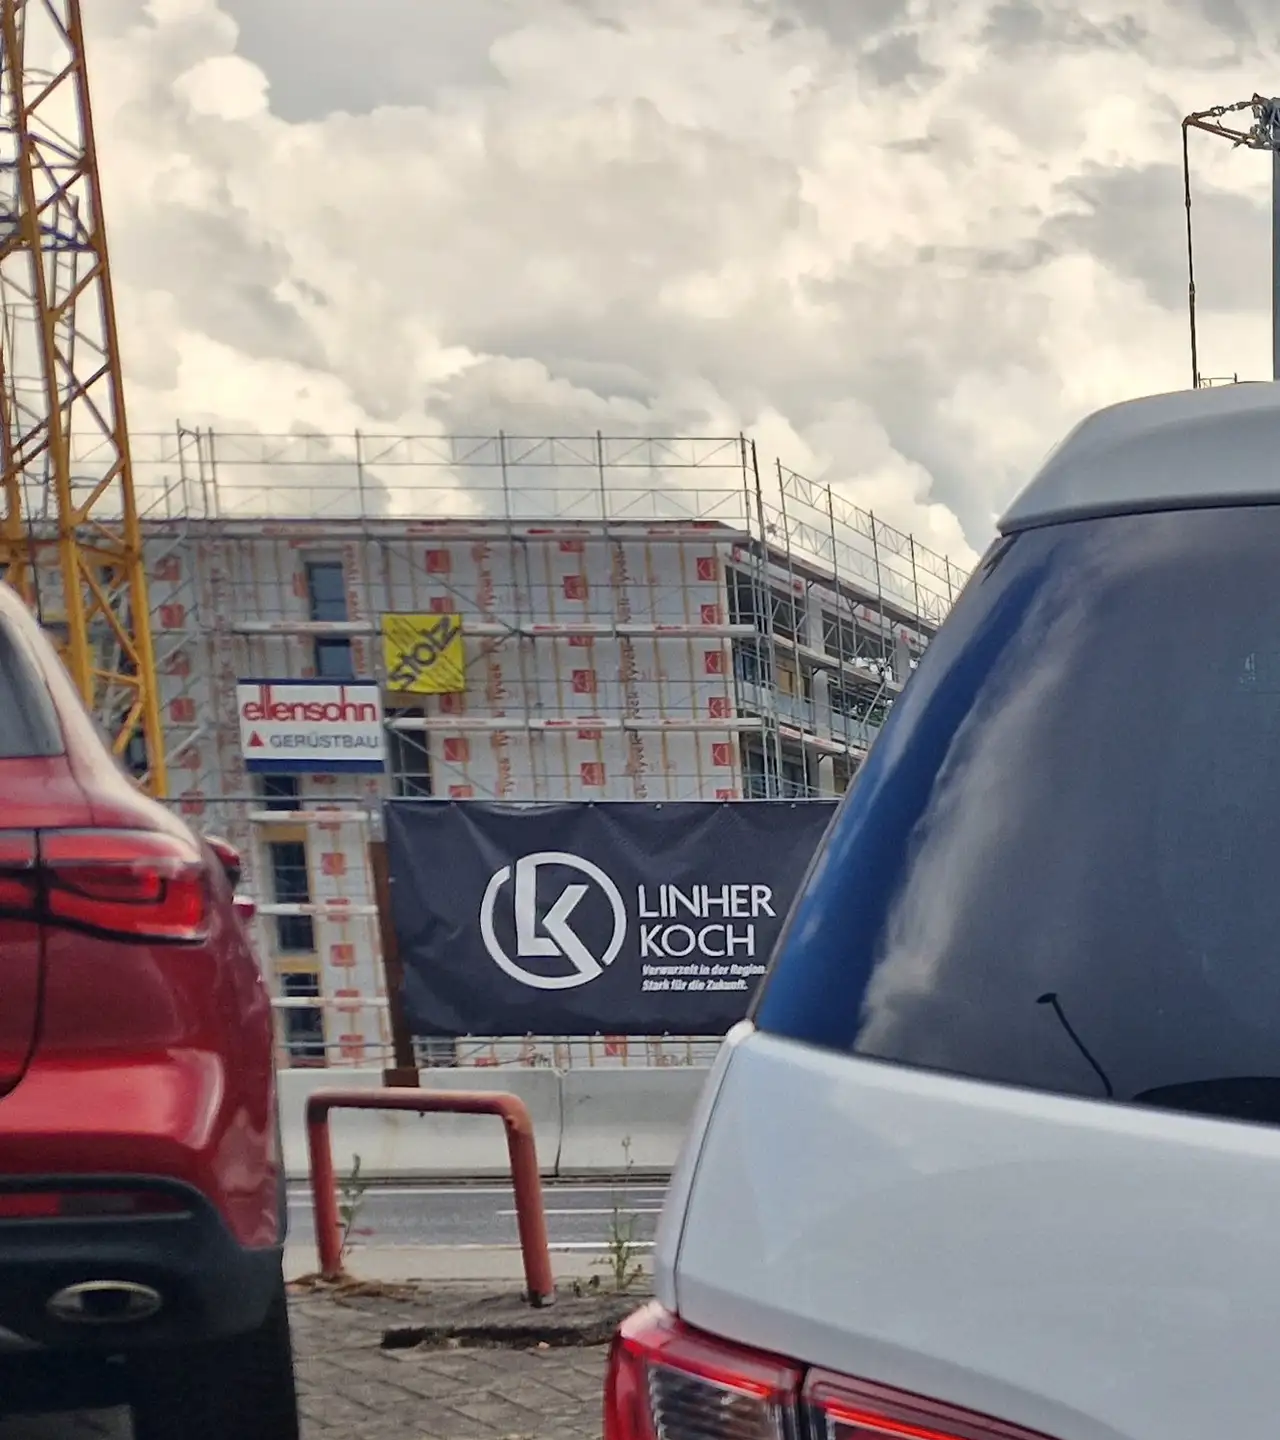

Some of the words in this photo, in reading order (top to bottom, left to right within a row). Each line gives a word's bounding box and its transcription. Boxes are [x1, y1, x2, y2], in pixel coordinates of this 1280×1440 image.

[243, 685, 377, 721] ellensohn
[269, 731, 378, 747] GERÜSTBAU
[637, 884, 776, 918] LINHER
[640, 924, 755, 957] KOCH
[711, 964, 729, 975] der
[641, 979, 670, 991] Stark
[687, 980, 705, 991] die
